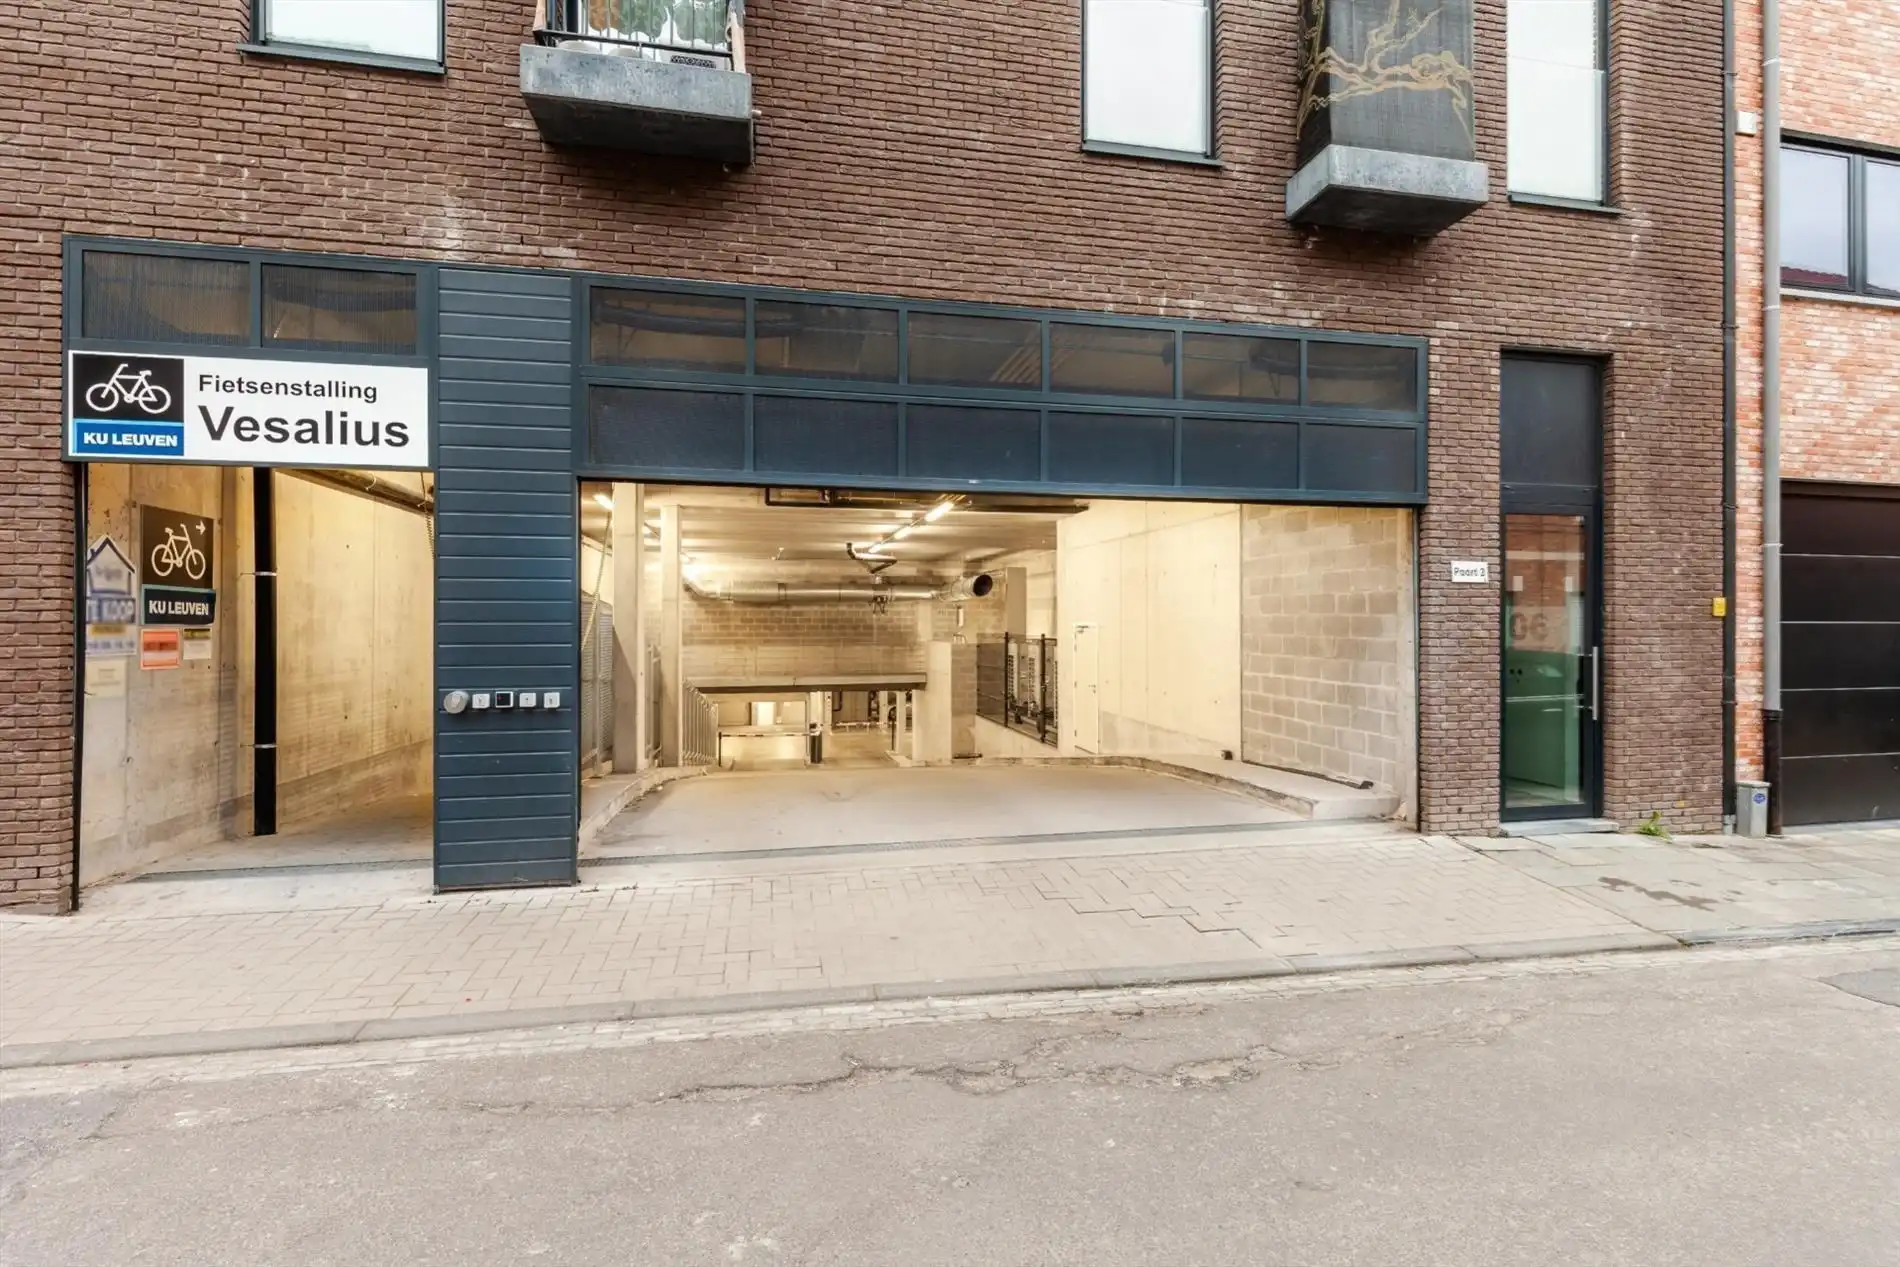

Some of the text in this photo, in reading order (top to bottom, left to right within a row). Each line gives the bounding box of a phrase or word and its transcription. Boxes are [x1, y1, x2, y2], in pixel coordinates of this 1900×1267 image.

[198, 374, 378, 404] Fietsenstalling
[198, 405, 410, 448] Vesalius
[83, 431, 178, 448] KU LEUVEN
[148, 599, 209, 616] KU LEUVEN
